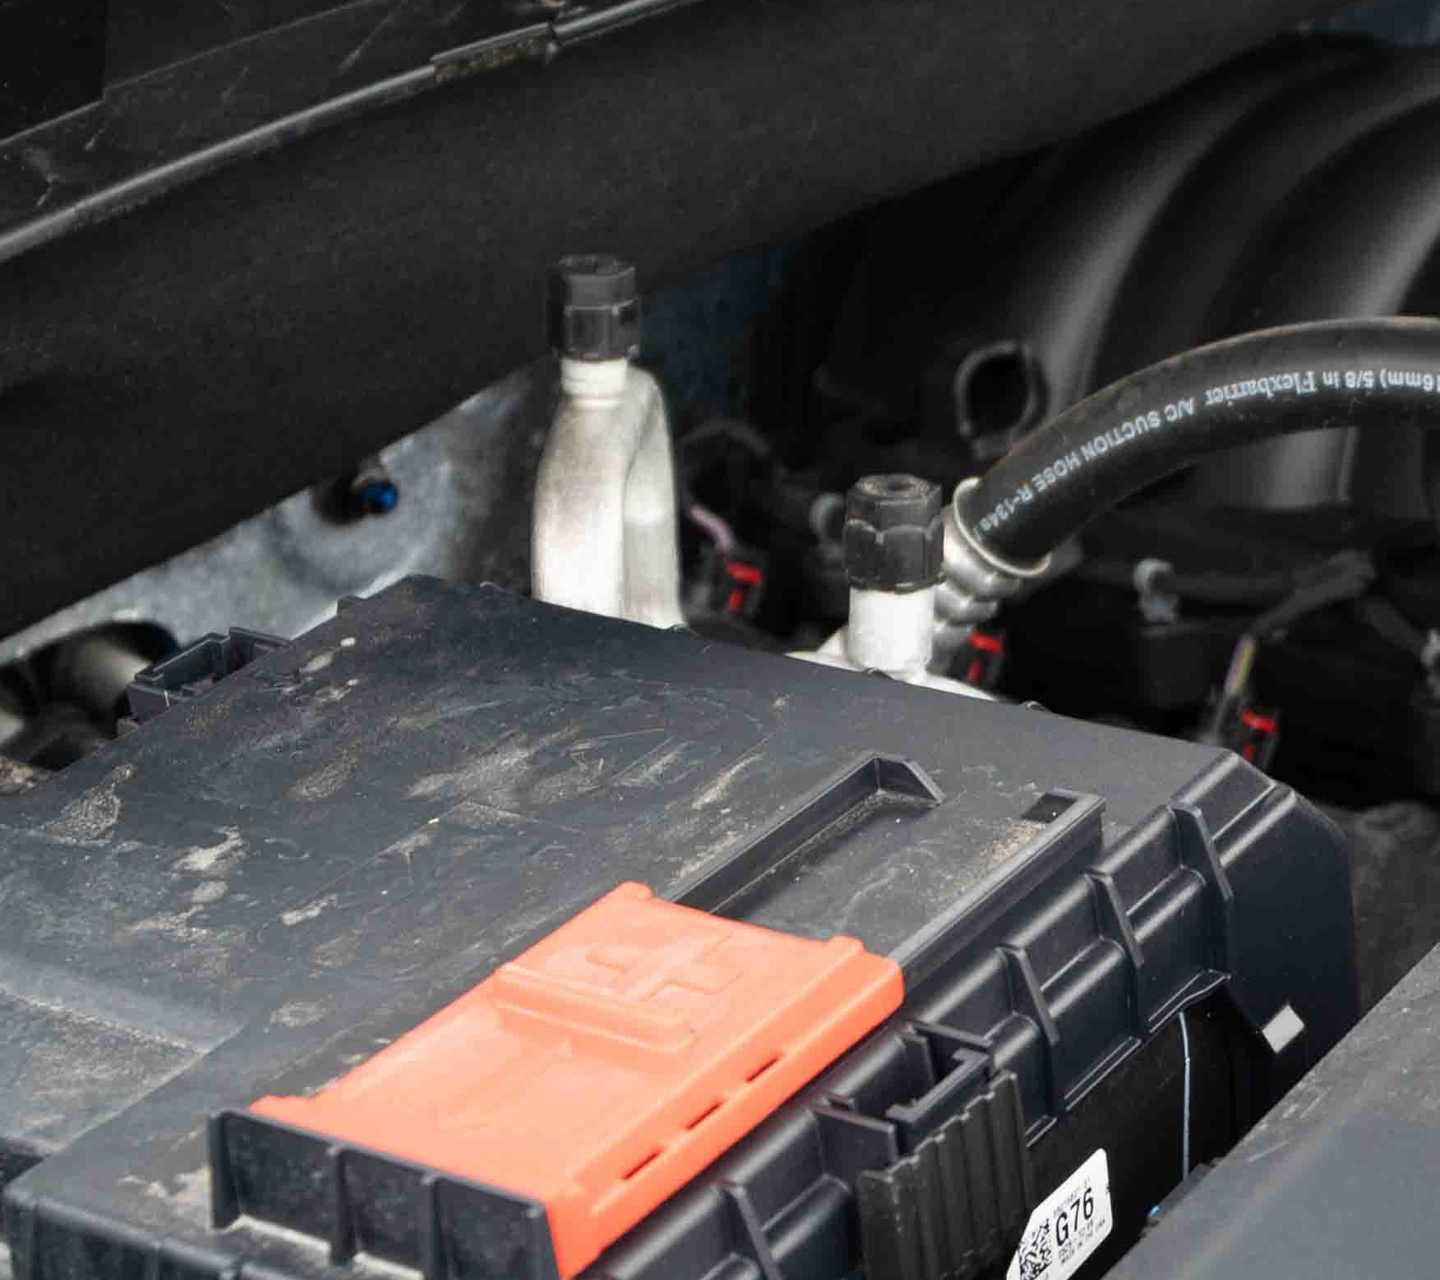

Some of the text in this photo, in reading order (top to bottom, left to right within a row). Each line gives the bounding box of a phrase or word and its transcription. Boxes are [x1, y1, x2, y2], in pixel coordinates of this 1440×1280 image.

[1204, 370, 1316, 408] Flexbarrier
[1322, 370, 1340, 389] in
[1344, 369, 1375, 389] 5/8
[1163, 396, 1195, 422] A/C
[1080, 410, 1161, 461] SUCTION
[1031, 451, 1081, 494] HOSE
[978, 484, 1033, 532] R-134a
[1056, 1188, 1094, 1246] G76
